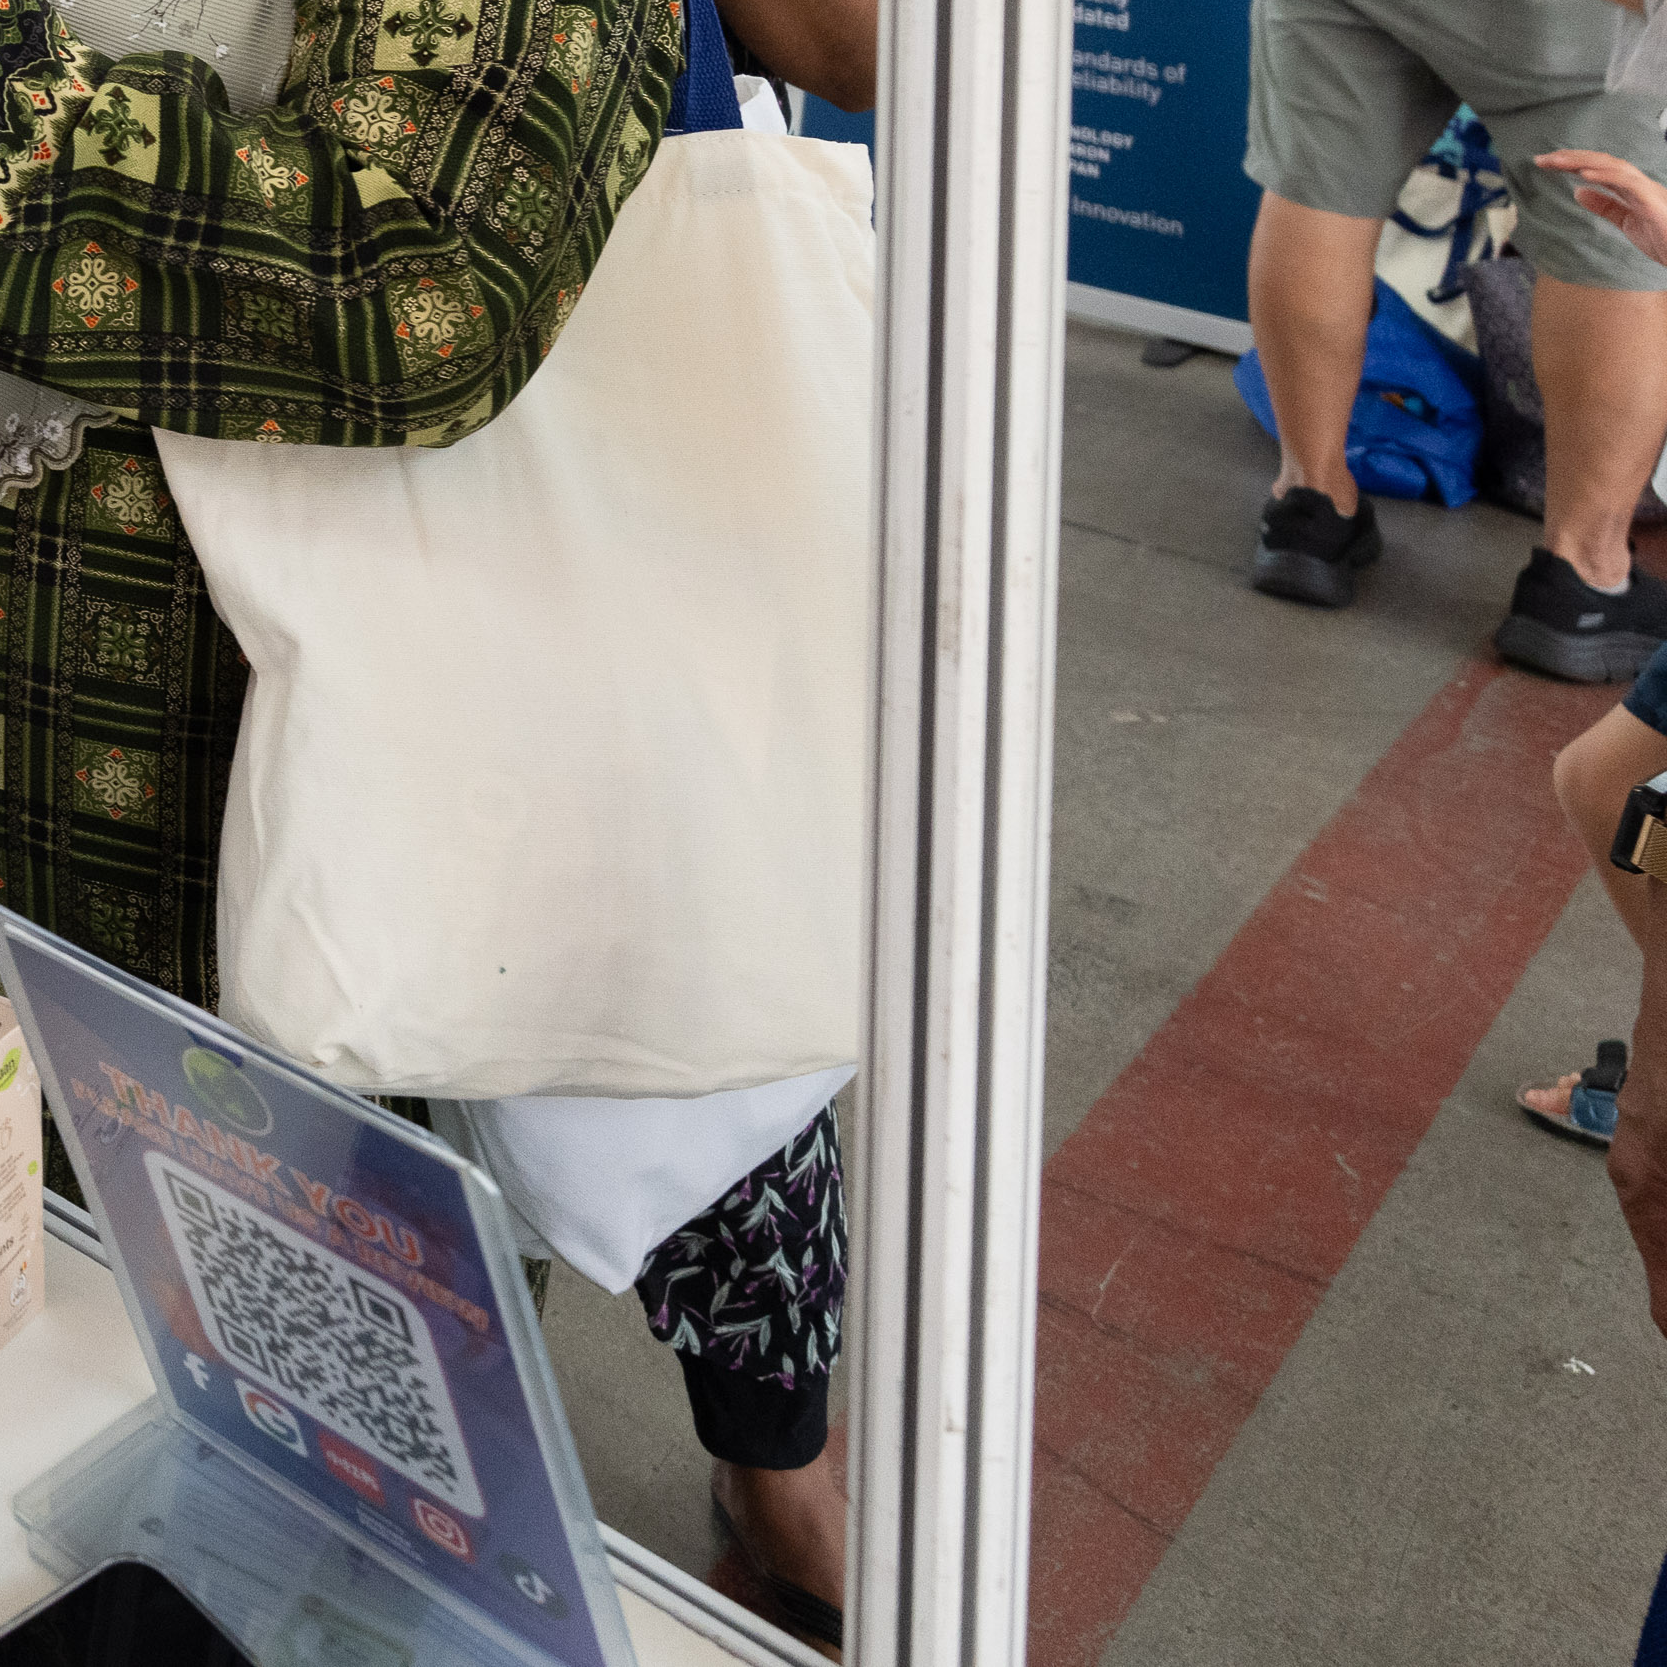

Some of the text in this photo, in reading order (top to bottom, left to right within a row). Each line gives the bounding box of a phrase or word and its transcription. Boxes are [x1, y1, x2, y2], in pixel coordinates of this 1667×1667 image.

[1163, 62, 1188, 84] of
[1071, 194, 1185, 240] Innovation
[99, 1061, 425, 1267] THANK YOU
